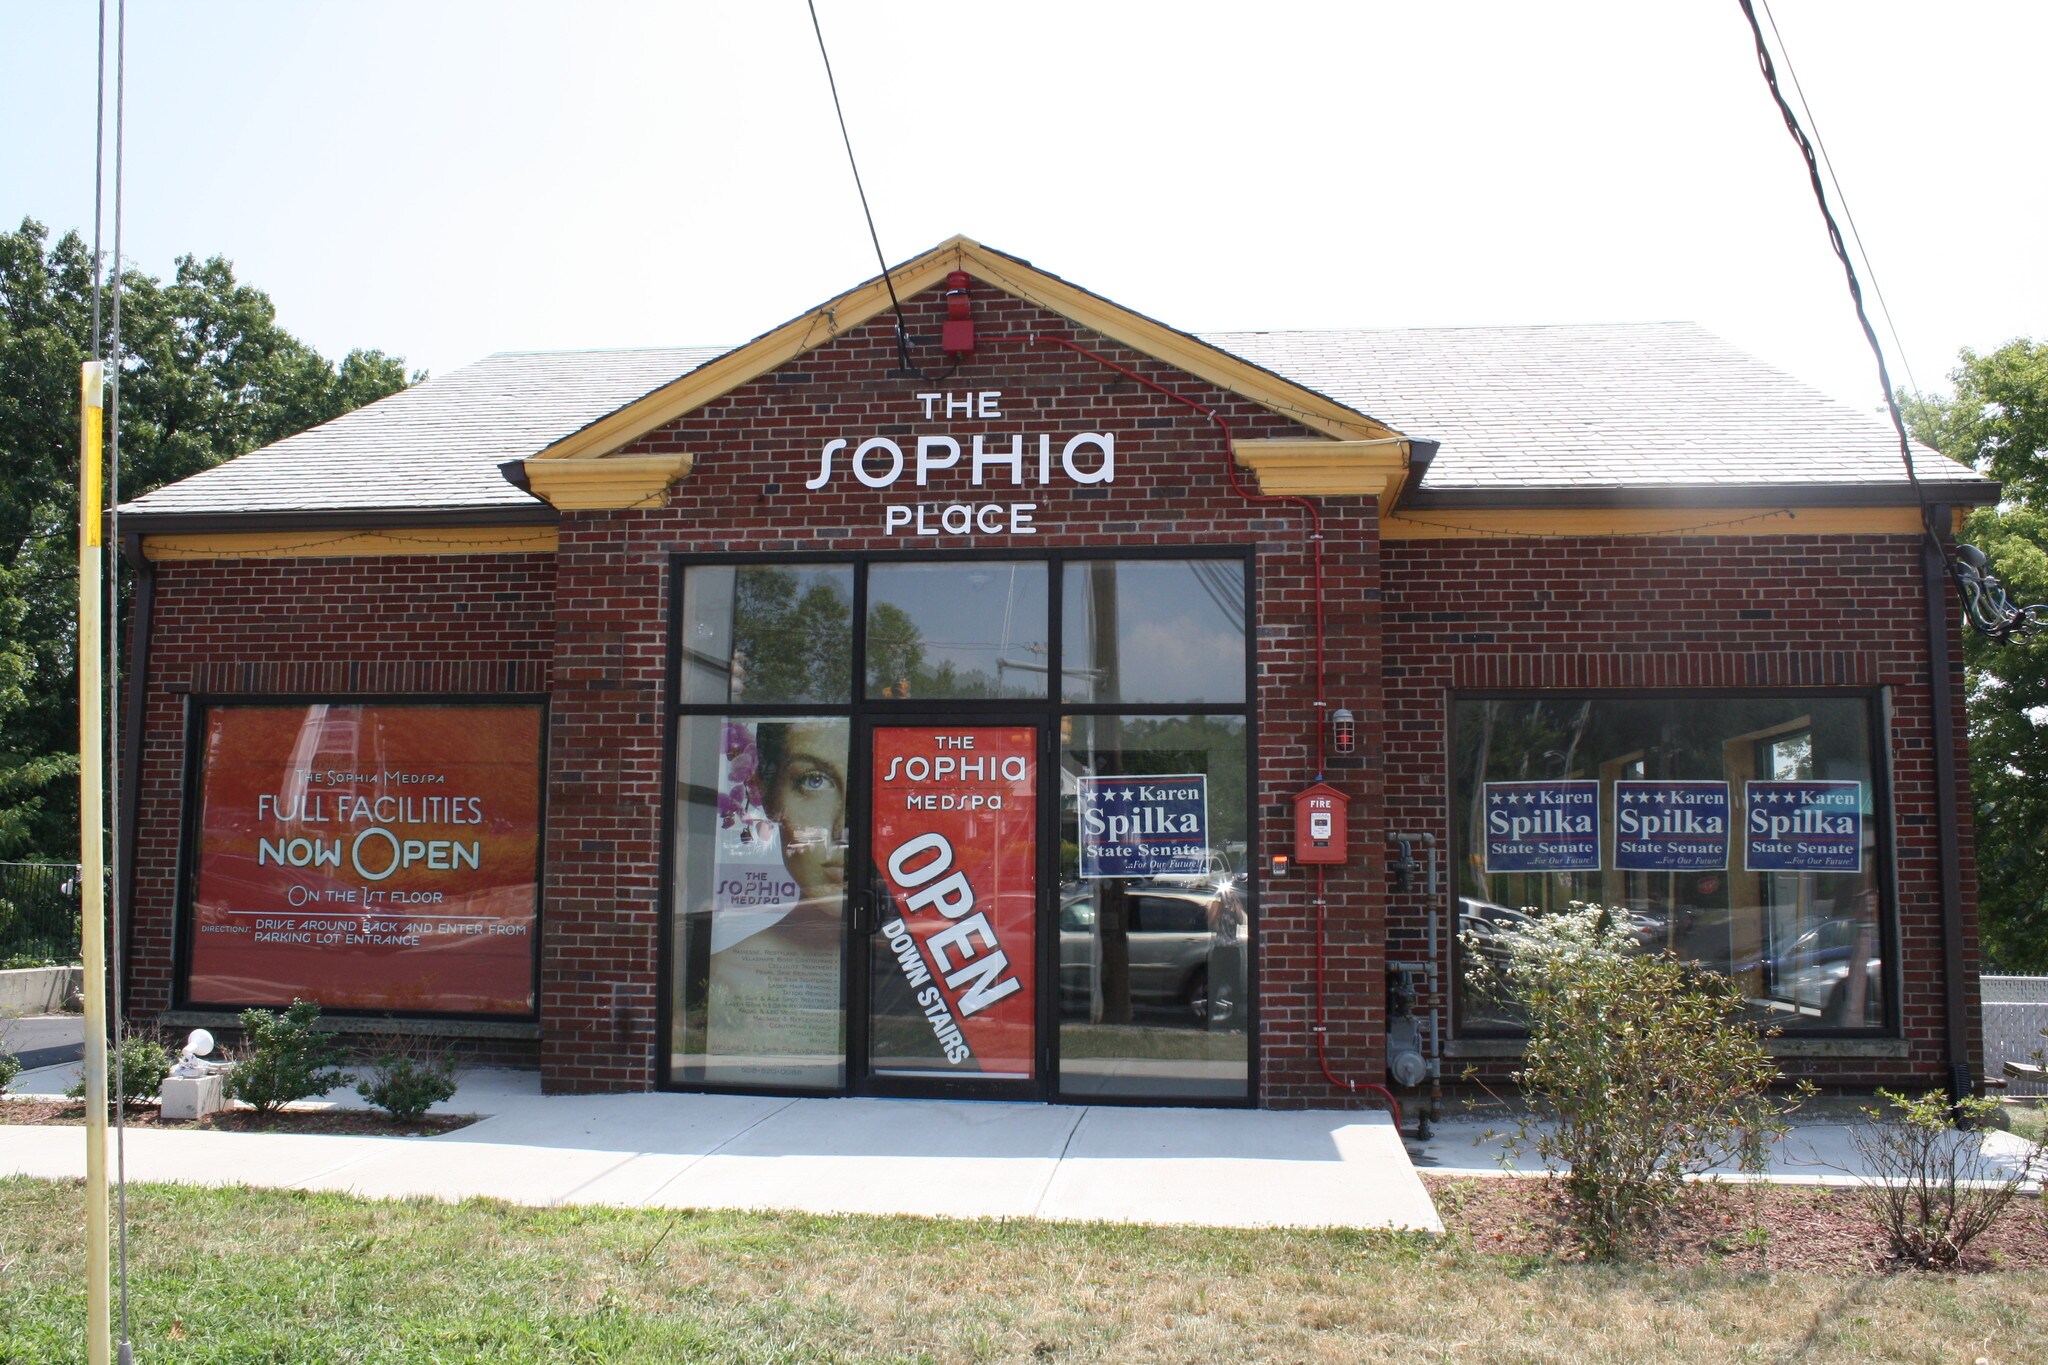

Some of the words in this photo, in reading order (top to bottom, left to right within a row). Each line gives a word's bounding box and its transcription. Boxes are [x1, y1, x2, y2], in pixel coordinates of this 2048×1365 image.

[916, 391, 1002, 420] THE
[934, 736, 975, 750] THE
[296, 769, 322, 786] THE
[1139, 786, 1200, 802] Karen
[1540, 790, 1593, 805] Karen
[1670, 790, 1724, 805] Karen
[1800, 790, 1855, 806] Karen
[258, 794, 329, 822] FULL
[338, 796, 482, 824] FACILITIES
[1310, 800, 1332, 808] FIRE
[1084, 807, 1200, 842] Spilka
[1489, 809, 1593, 841] Spilka
[1620, 808, 1724, 840] Spilka
[1750, 808, 1854, 840] Spilka
[258, 838, 341, 867] NOW
[352, 827, 480, 880] OPEN
[1087, 844, 1132, 857] State
[1138, 844, 1200, 857] Senate
[1491, 842, 1533, 855] State
[1538, 842, 1593, 854] Senate
[1620, 842, 1662, 854] State
[1667, 842, 1723, 854] Senate
[1751, 842, 1793, 854] State
[1797, 842, 1854, 855] Senate
[745, 872, 768, 880] THE
[288, 885, 320, 906] ON
[325, 890, 357, 903] THE
[361, 886, 386, 908] 1ST
[390, 892, 443, 904] FLOOR
[201, 925, 252, 934] DIRECTIONS:
[255, 919, 295, 931] DRIVE
[298, 920, 357, 932] AROUND
[361, 921, 398, 933] BACK
[402, 922, 434, 934] AND
[438, 923, 484, 935] ENTER
[488, 924, 527, 936] FROM
[887, 831, 1022, 1019] OPEN
[254, 932, 311, 944] PARKING
[316, 933, 341, 944] LOT
[344, 934, 420, 946] ENTRANCE
[882, 917, 931, 989] DOWN
[917, 986, 971, 1065] STAIRS
